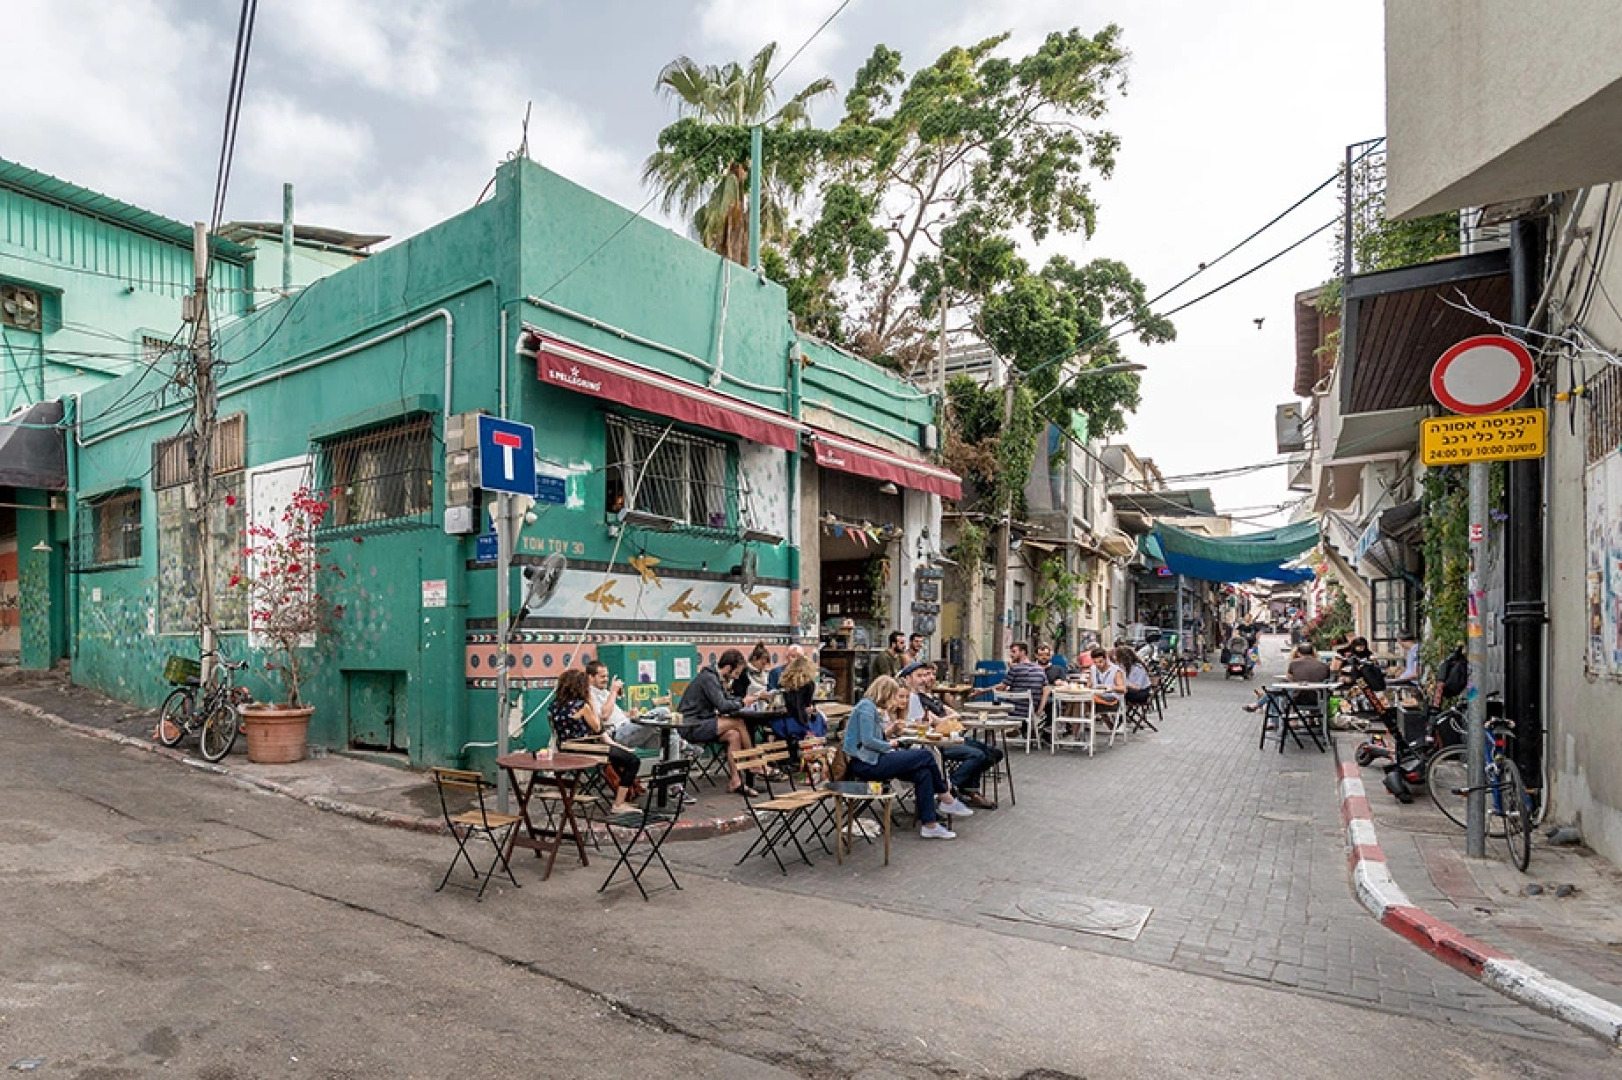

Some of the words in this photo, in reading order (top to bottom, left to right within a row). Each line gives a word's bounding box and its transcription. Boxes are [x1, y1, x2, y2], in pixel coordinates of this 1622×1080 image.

[1482, 415, 1537, 428] הכניסה
[1430, 421, 1477, 434] אסורה
[1498, 426, 1525, 440] לכל
[1442, 434, 1468, 445] רכב
[1472, 431, 1493, 442] כלי
[1460, 448, 1473, 456] עד
[1476, 445, 1504, 455] 10:00
[1506, 443, 1537, 453] משעה
[1430, 449, 1458, 460] 24:00
[572, 541, 585, 555] 30
